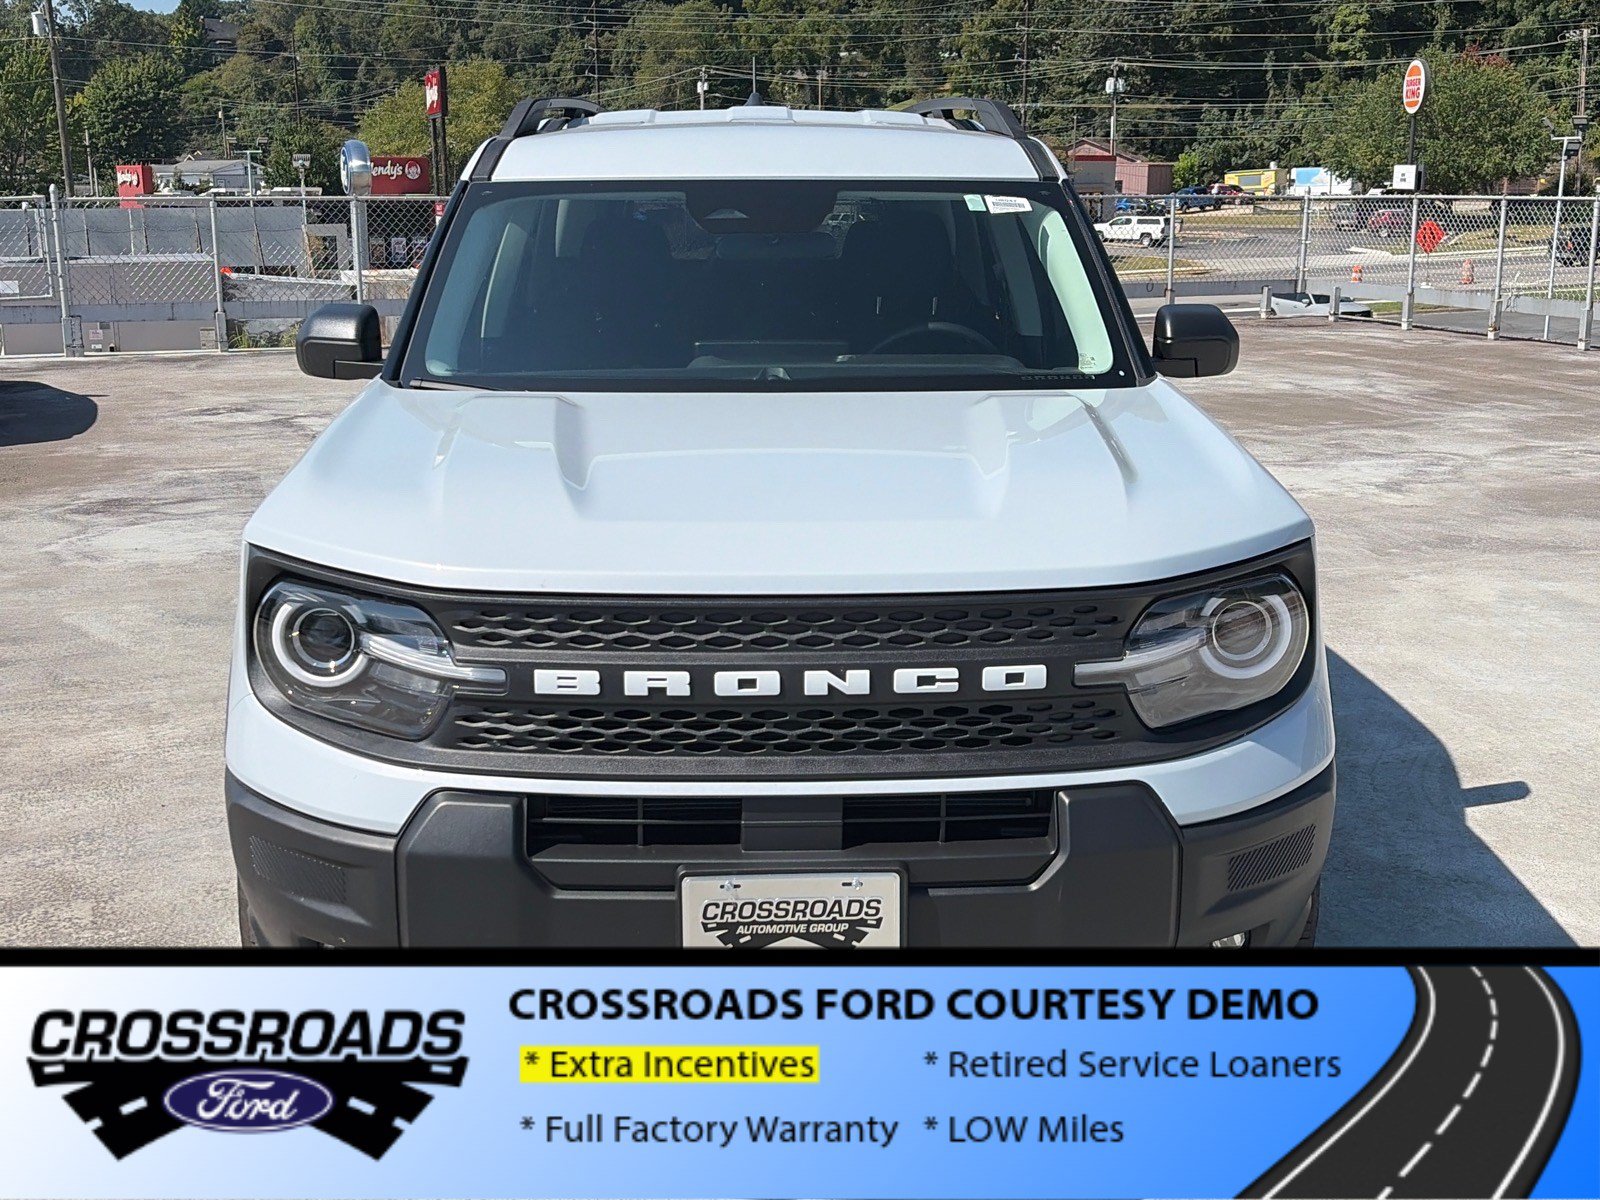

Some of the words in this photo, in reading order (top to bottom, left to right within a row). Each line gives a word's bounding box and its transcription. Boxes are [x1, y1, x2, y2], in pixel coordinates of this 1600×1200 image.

[1405, 87, 1420, 99] KING
[534, 664, 1047, 697] BRONCO
[702, 898, 882, 921] CROSSROADS
[736, 924, 807, 935] AUTOMOTIVE
[809, 922, 849, 933] GROUP
